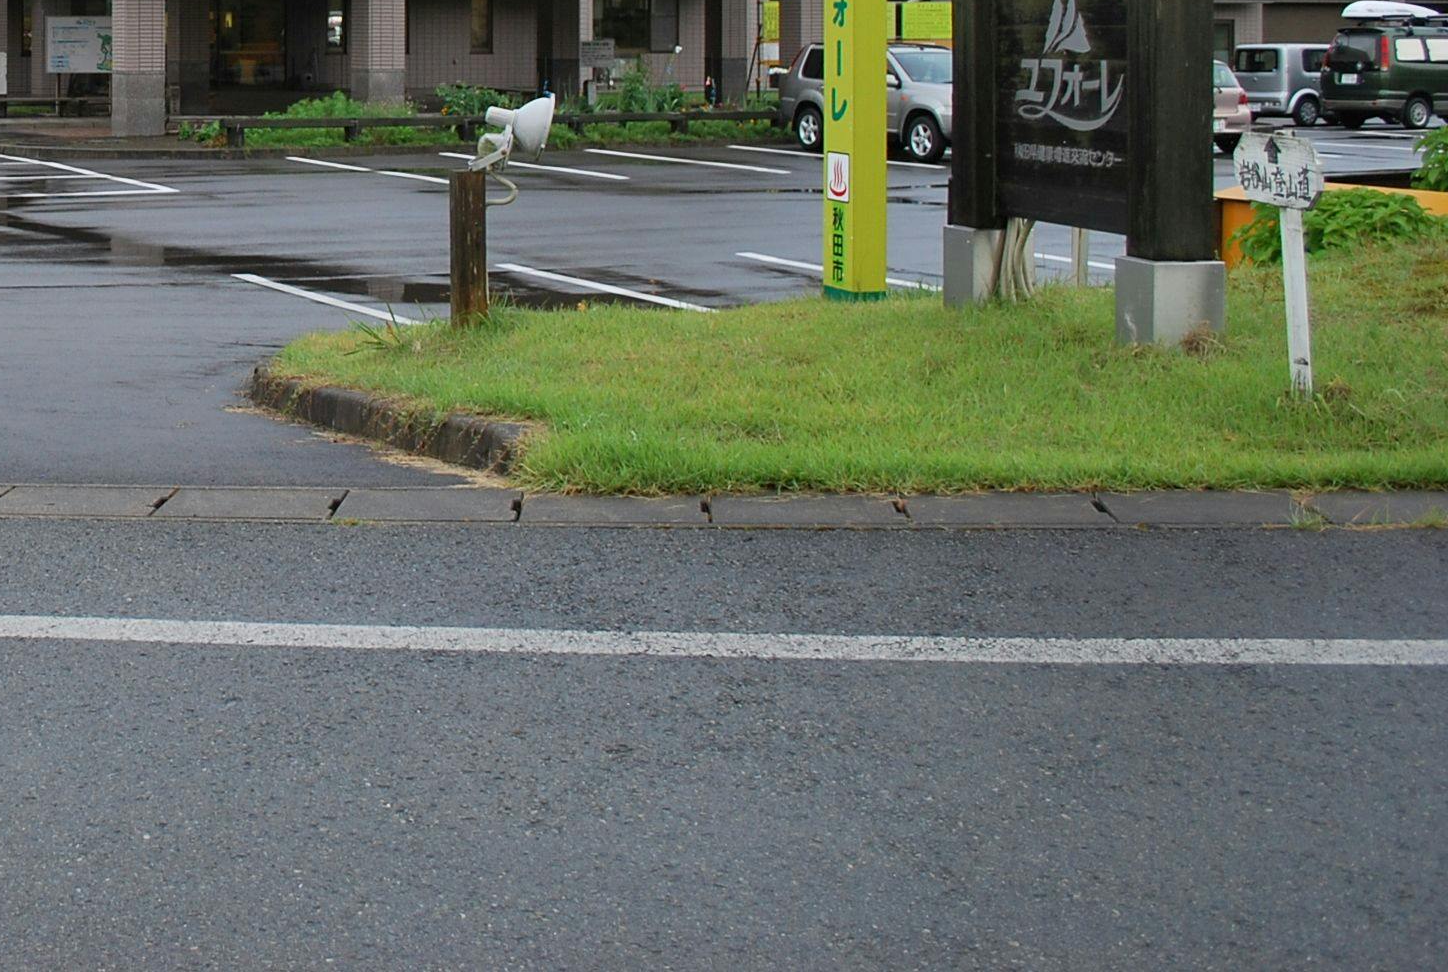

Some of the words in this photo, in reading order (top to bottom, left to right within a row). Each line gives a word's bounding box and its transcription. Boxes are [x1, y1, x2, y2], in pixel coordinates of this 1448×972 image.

[1014, 58, 1125, 121] ユフォーレ
[832, 207, 844, 282] 秋田市
